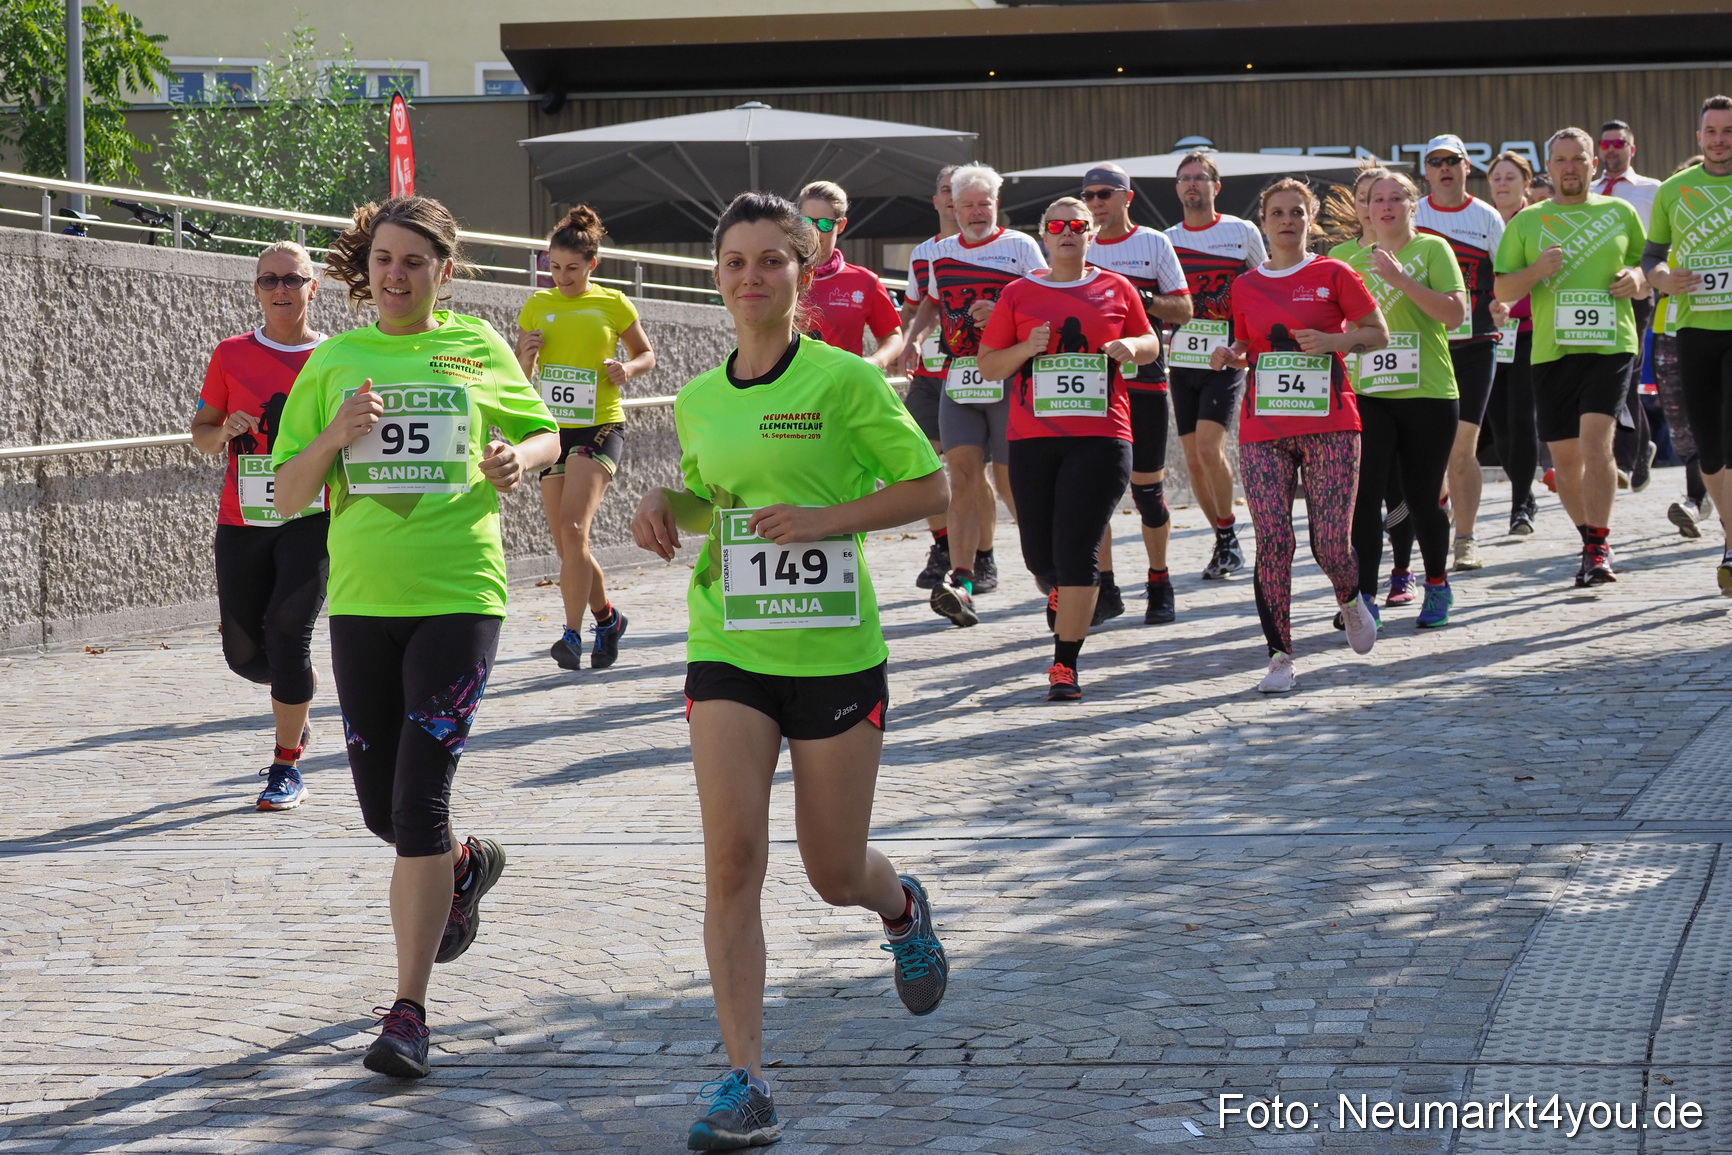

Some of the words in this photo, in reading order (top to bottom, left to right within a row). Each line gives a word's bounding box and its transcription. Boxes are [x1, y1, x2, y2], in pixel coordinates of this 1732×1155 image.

[1689, 253, 1732, 269] BOC
[1704, 272, 1729, 291] 97
[1560, 292, 1611, 305] BOCK
[1695, 294, 1732, 304] NIKOLA
[1575, 309, 1599, 325] 99
[1564, 330, 1608, 339] STEPHAN
[1187, 336, 1208, 352] 81
[430, 361, 483, 377] ELEMENTELAUF
[432, 355, 483, 369] NEUMARKTER
[1039, 355, 1102, 371] BOCK
[1262, 354, 1325, 370] BOCK
[1374, 353, 1398, 372] 98
[543, 367, 592, 384] BOCK
[962, 370, 983, 385] 80
[1278, 374, 1306, 393] 54
[1372, 375, 1399, 386] ANNA
[1056, 375, 1086, 394] 56
[372, 387, 460, 414] OCK
[551, 385, 575, 404] 66
[952, 389, 994, 398] STEPHAN
[1050, 400, 1092, 409] NICOLE
[1268, 399, 1316, 409] KORONA
[551, 407, 576, 418] ELISA
[763, 412, 821, 421] NEUMARKTER
[759, 422, 823, 431] ELEMENTELAUF
[381, 422, 430, 455] 95
[367, 466, 446, 480] SANDRA
[262, 509, 302, 520] TAA
[750, 548, 829, 587] 149
[756, 597, 823, 615] TANJA
[842, 702, 858, 716] asics
